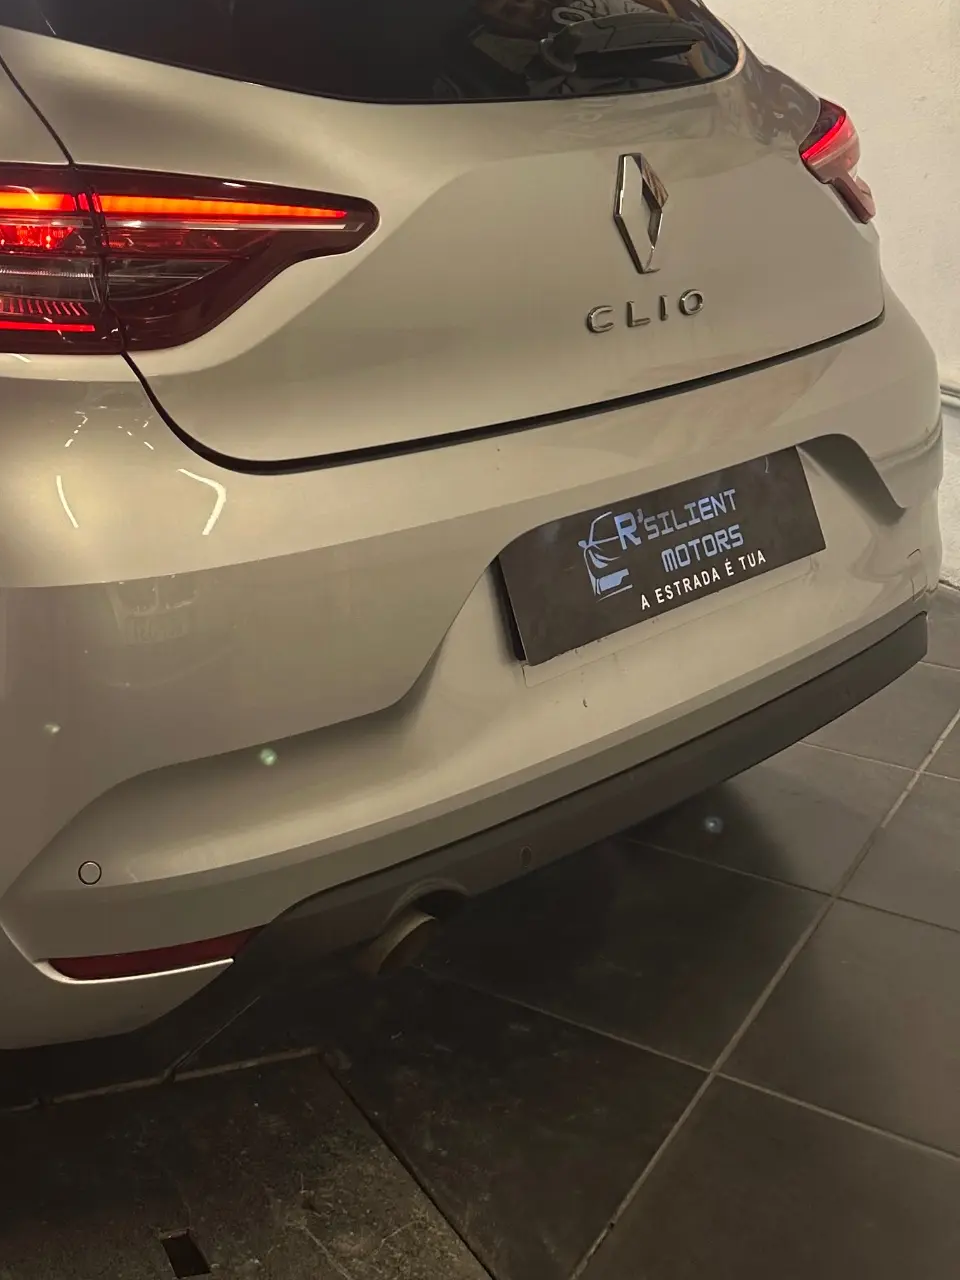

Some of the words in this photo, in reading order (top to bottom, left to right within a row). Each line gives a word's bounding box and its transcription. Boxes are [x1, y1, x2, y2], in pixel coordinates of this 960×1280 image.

[586, 288, 705, 334] CLIO
[614, 488, 737, 550] R'SILIENT
[661, 524, 744, 574] MOTORS
[640, 594, 651, 610] A
[655, 567, 721, 605] ESTRADA
[724, 558, 735, 577] É
[738, 549, 767, 572] TUA
